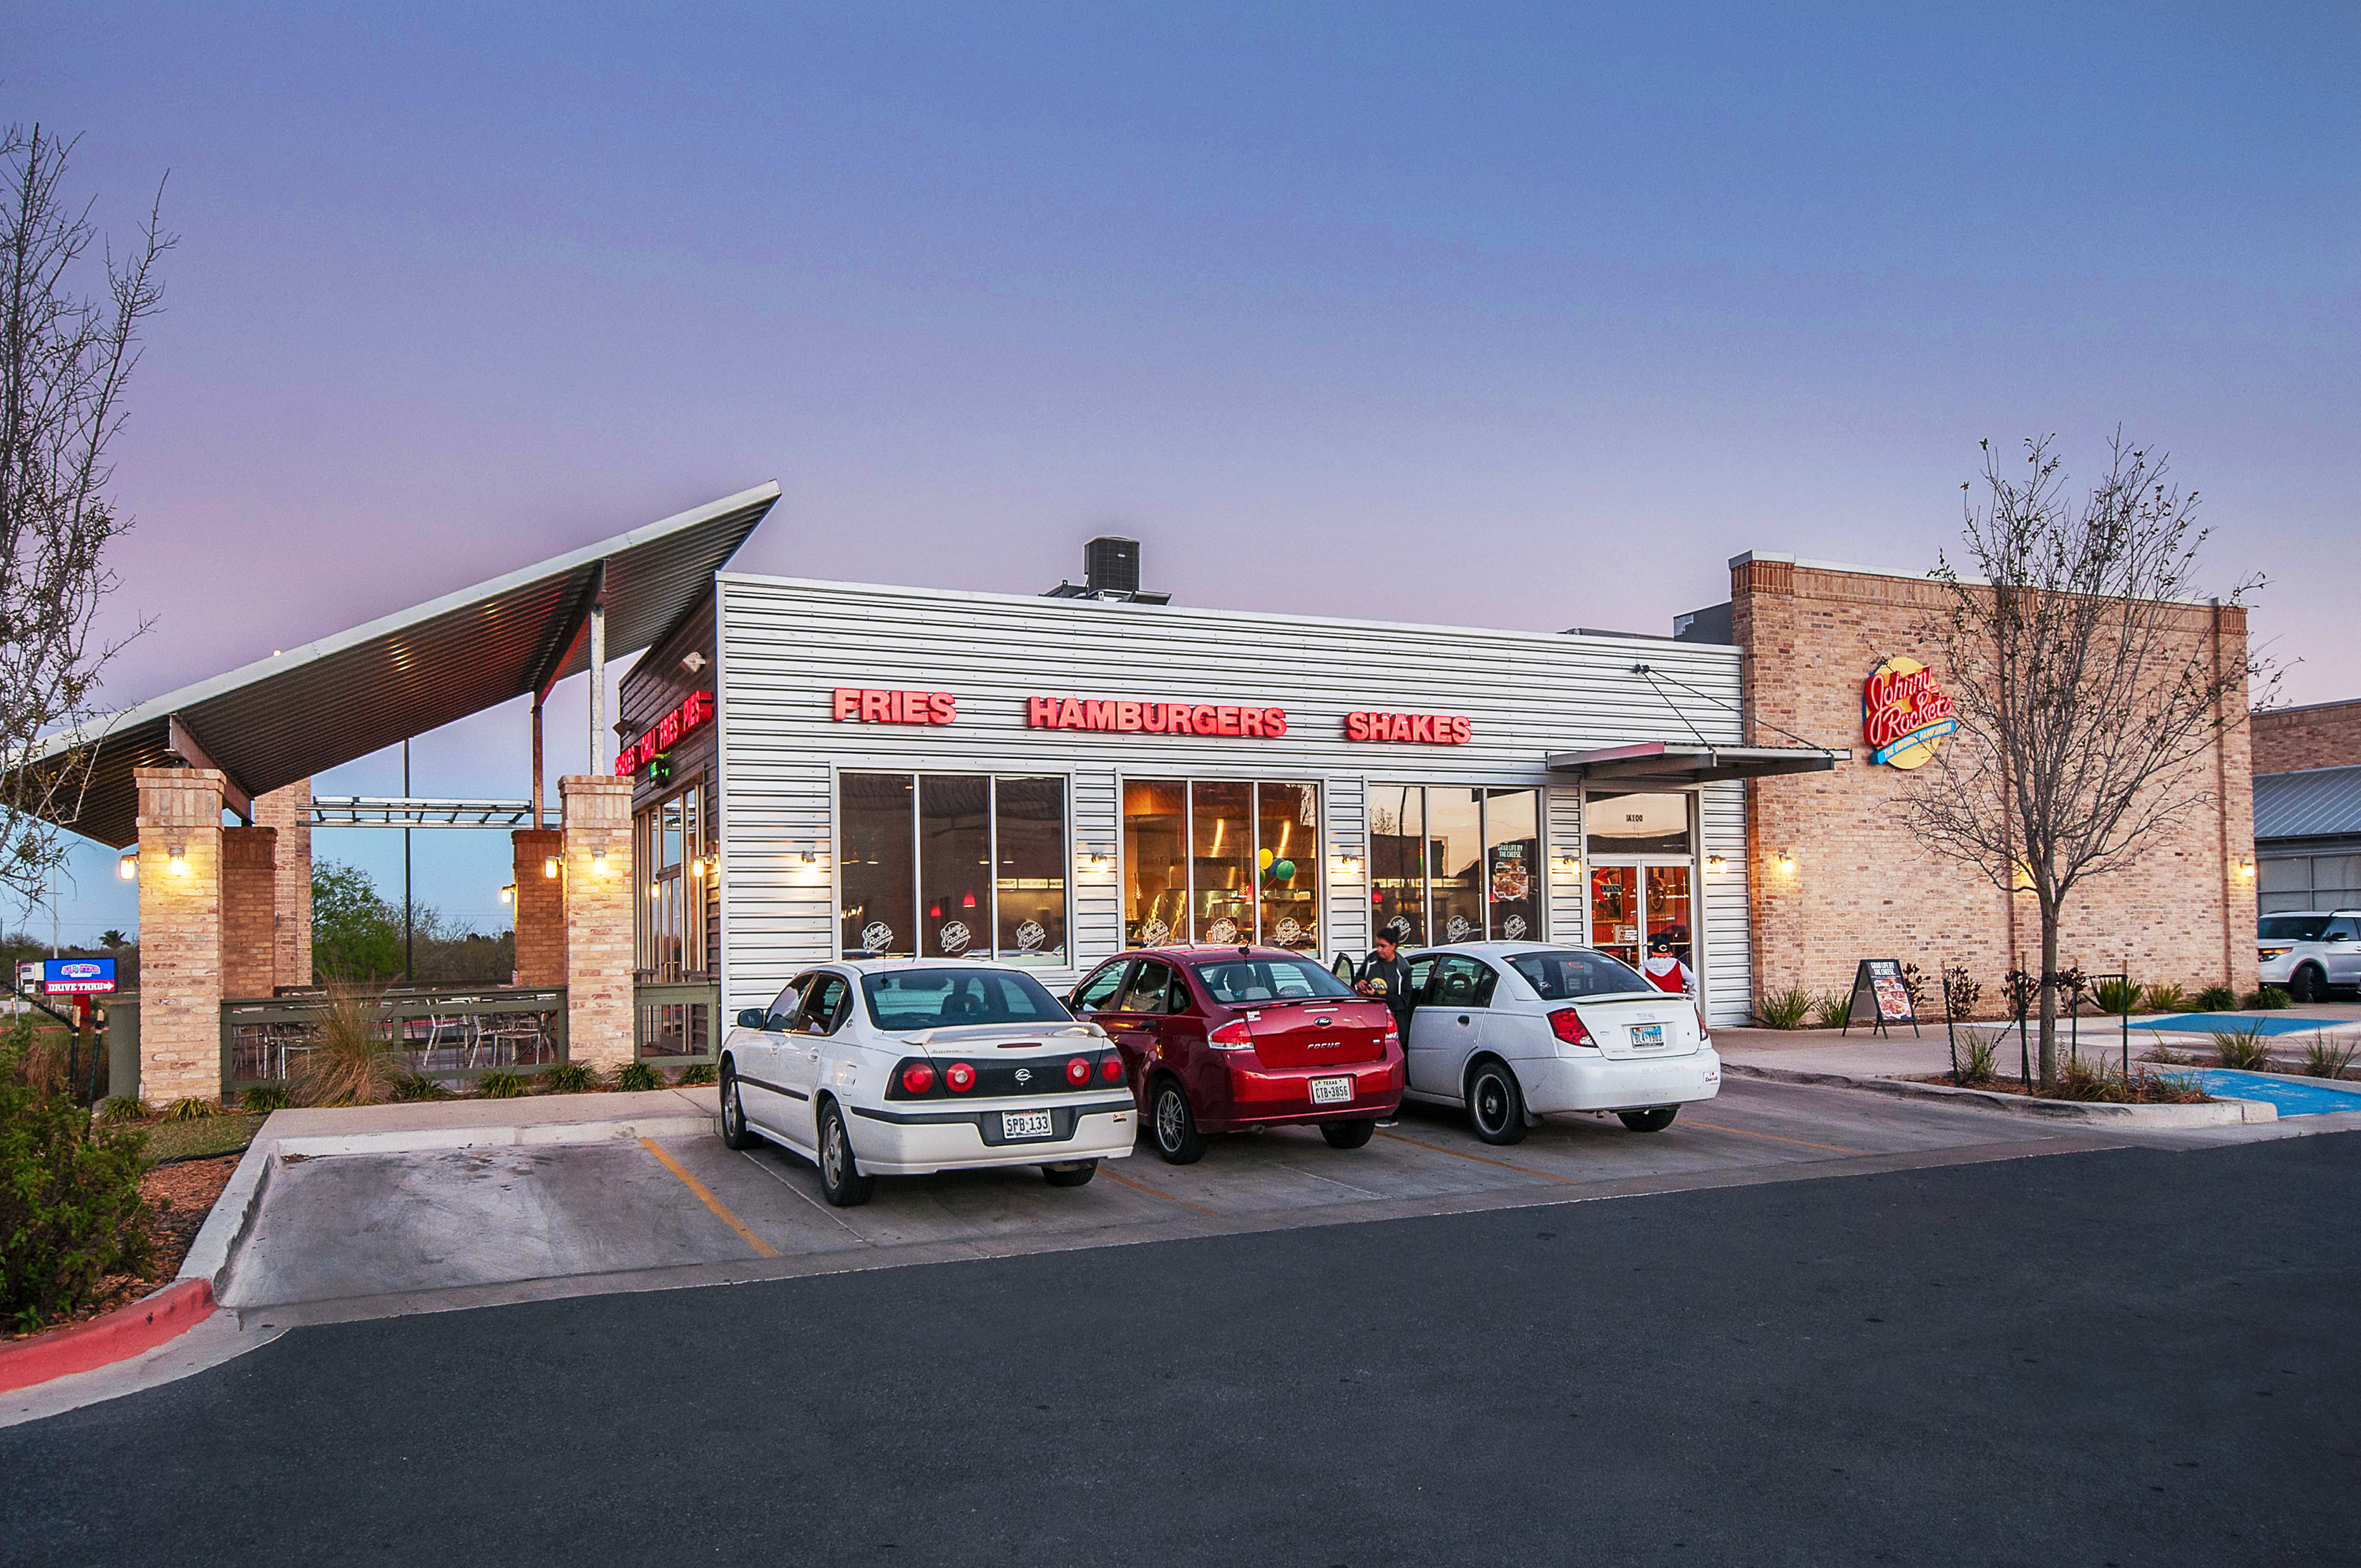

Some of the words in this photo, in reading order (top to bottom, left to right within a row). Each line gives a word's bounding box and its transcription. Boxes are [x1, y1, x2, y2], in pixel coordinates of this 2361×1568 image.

[659, 708, 678, 750] FRIES
[683, 690, 701, 732] PIES
[834, 687, 957, 725] FRIES
[1028, 696, 1288, 738] HAMBURGERS
[1869, 665, 1941, 745] Johnny
[1881, 690, 1954, 748] Rockets
[1347, 711, 1472, 745] SHAKES
[48, 983, 77, 991] DRIVE
[77, 982, 104, 991] THRU
